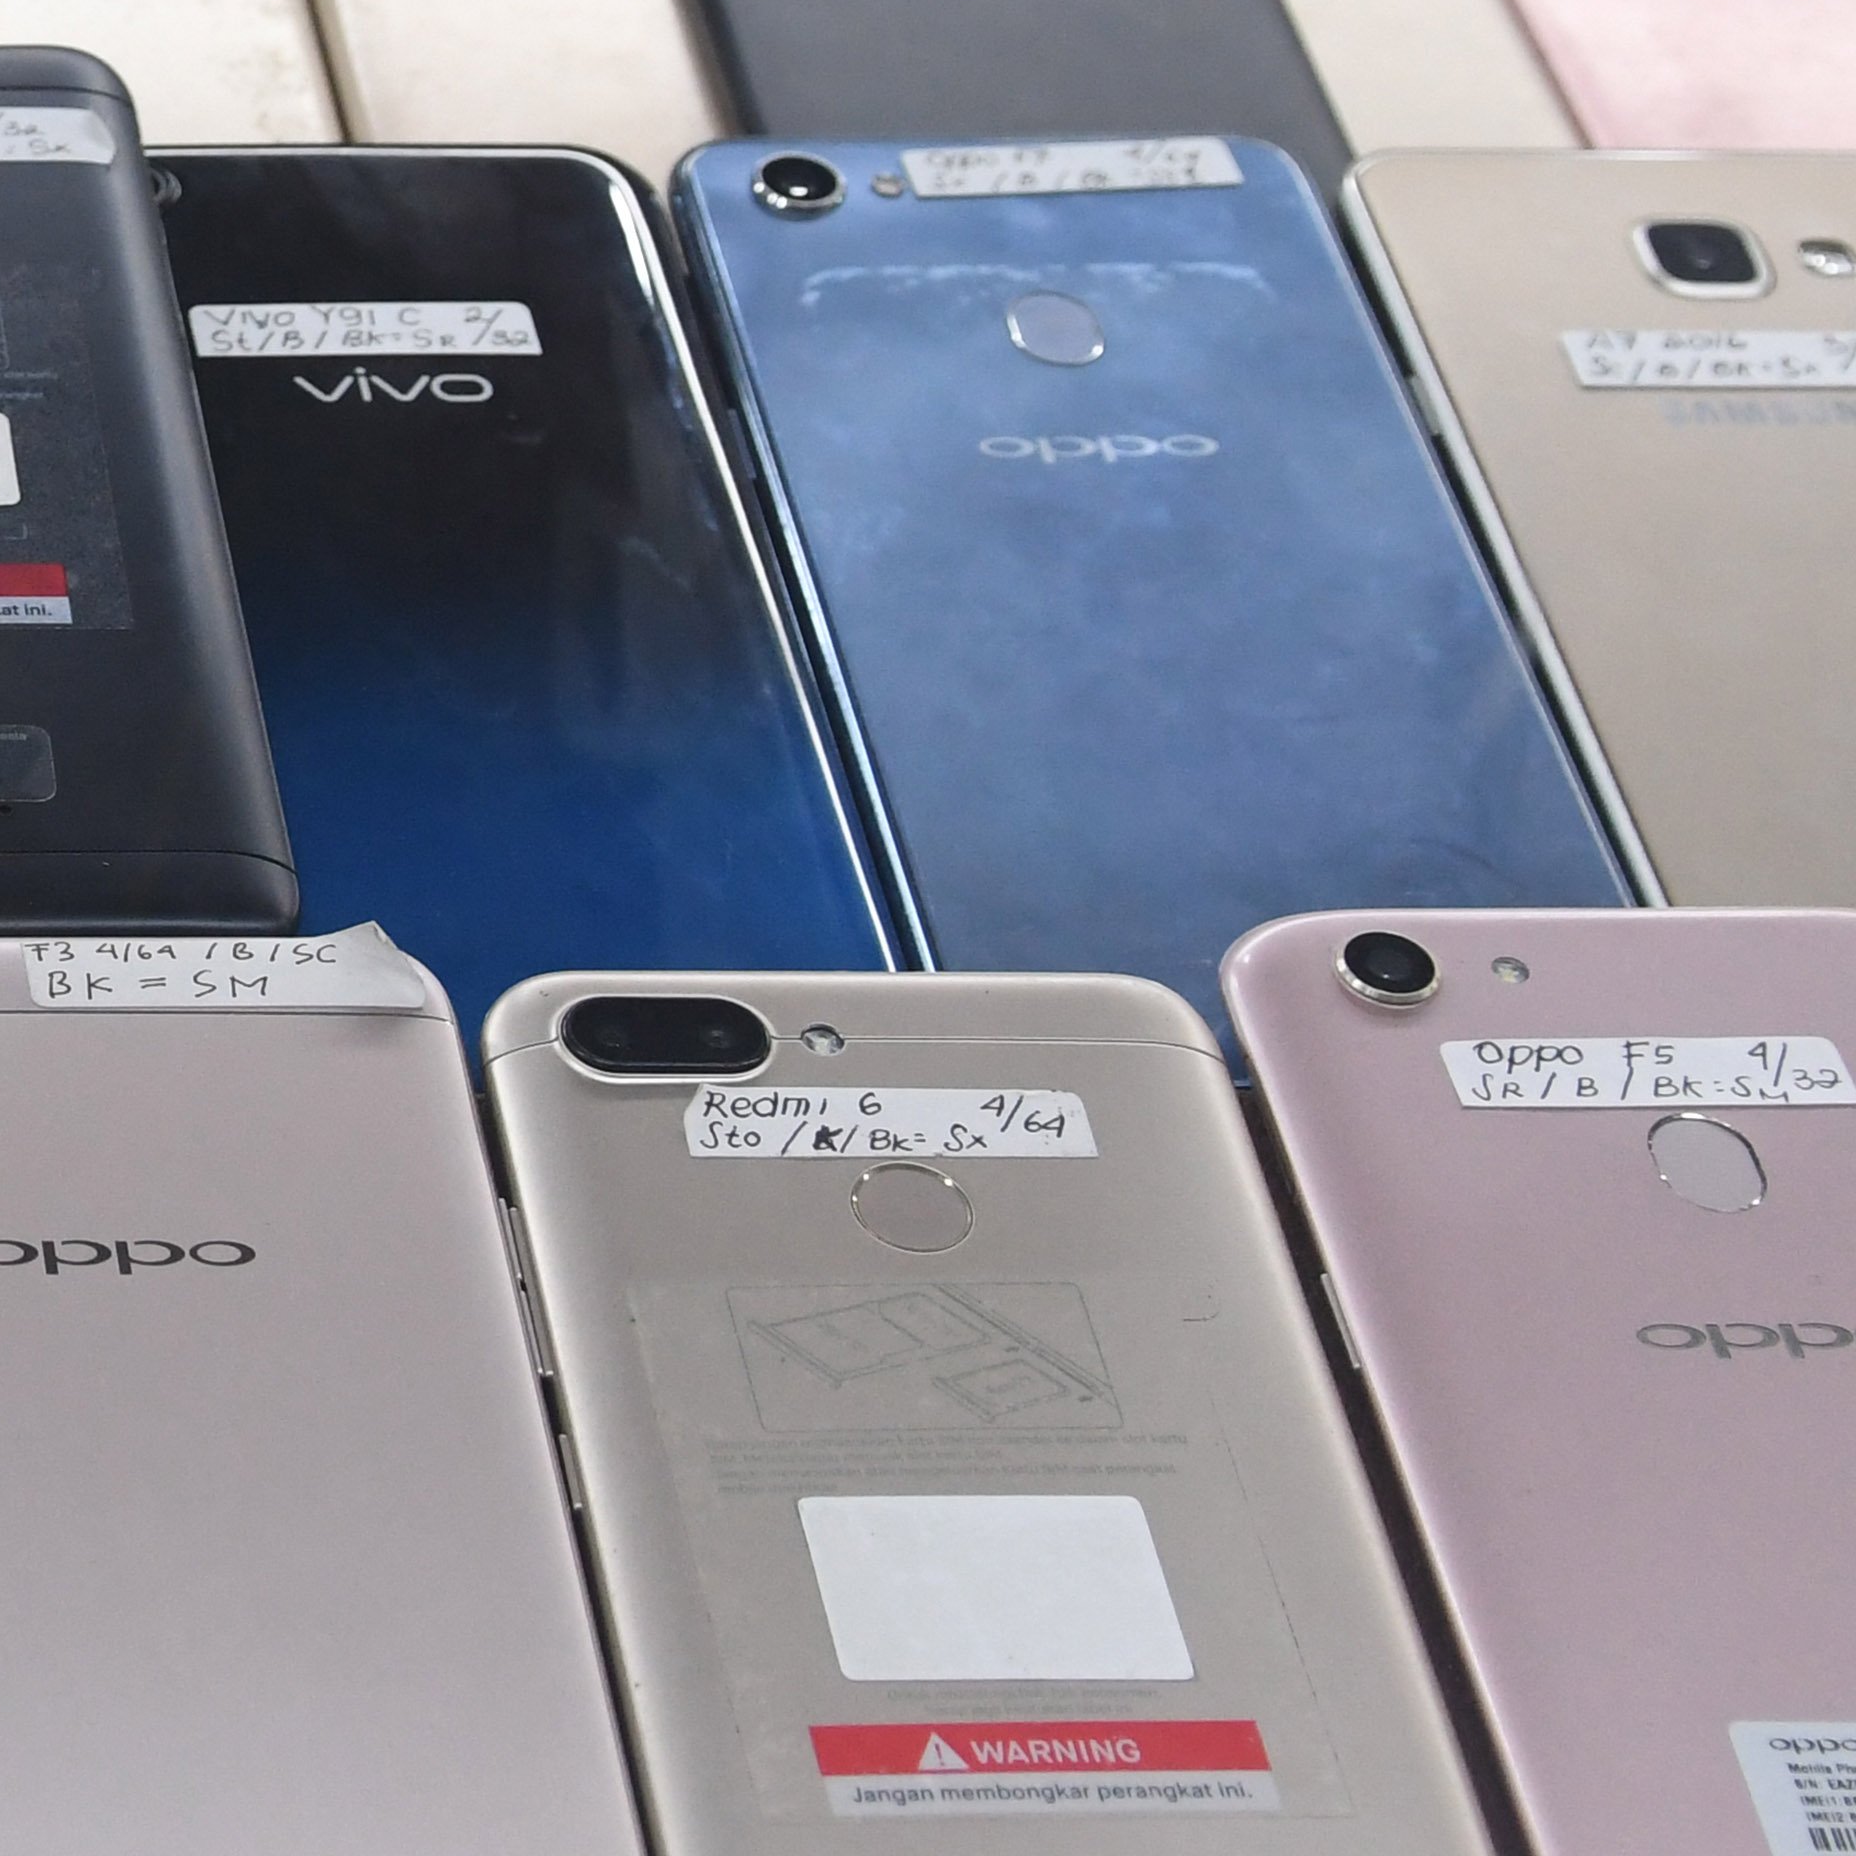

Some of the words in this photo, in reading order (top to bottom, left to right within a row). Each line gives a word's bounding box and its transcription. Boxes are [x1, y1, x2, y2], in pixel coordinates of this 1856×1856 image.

[293, 366, 494, 403] vivo
[979, 434, 1220, 464] oppo
[24, 603, 52, 616] ini.
[702, 1092, 827, 1118] Redmi
[858, 1092, 882, 1115] 6
[1636, 1322, 1856, 1359] opp
[970, 1738, 1141, 1765] WARNING
[853, 1786, 934, 1807] Jangan
[940, 1784, 1090, 1805] membongkar
[1098, 1782, 1212, 1804] perangkat
[1218, 1781, 1252, 1799] ini.
